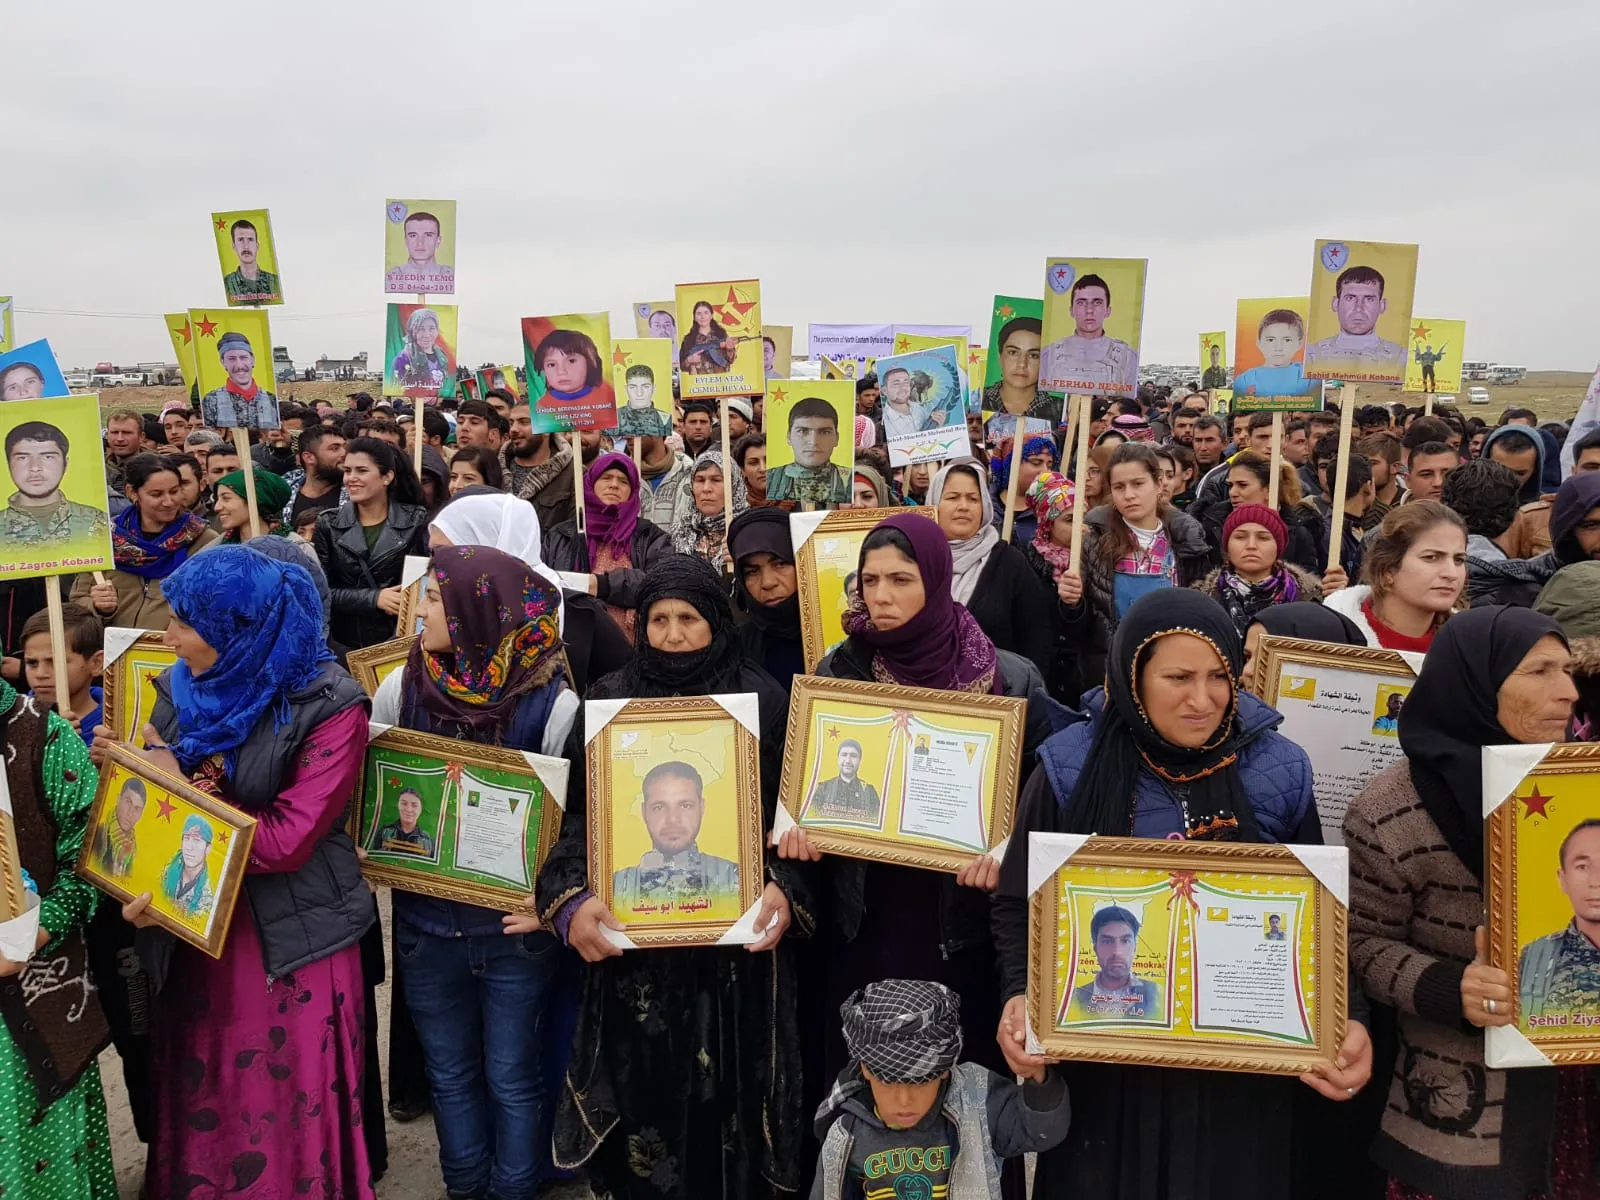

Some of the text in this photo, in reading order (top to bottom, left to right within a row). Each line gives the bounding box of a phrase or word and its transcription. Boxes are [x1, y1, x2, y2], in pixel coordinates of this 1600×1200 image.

[1053, 379, 1095, 390] FERHAD
[19, 560, 58, 571] Zagros
[632, 895, 713, 915] الشهيد ابو سيف
[863, 1145, 952, 1179] GUCCI
